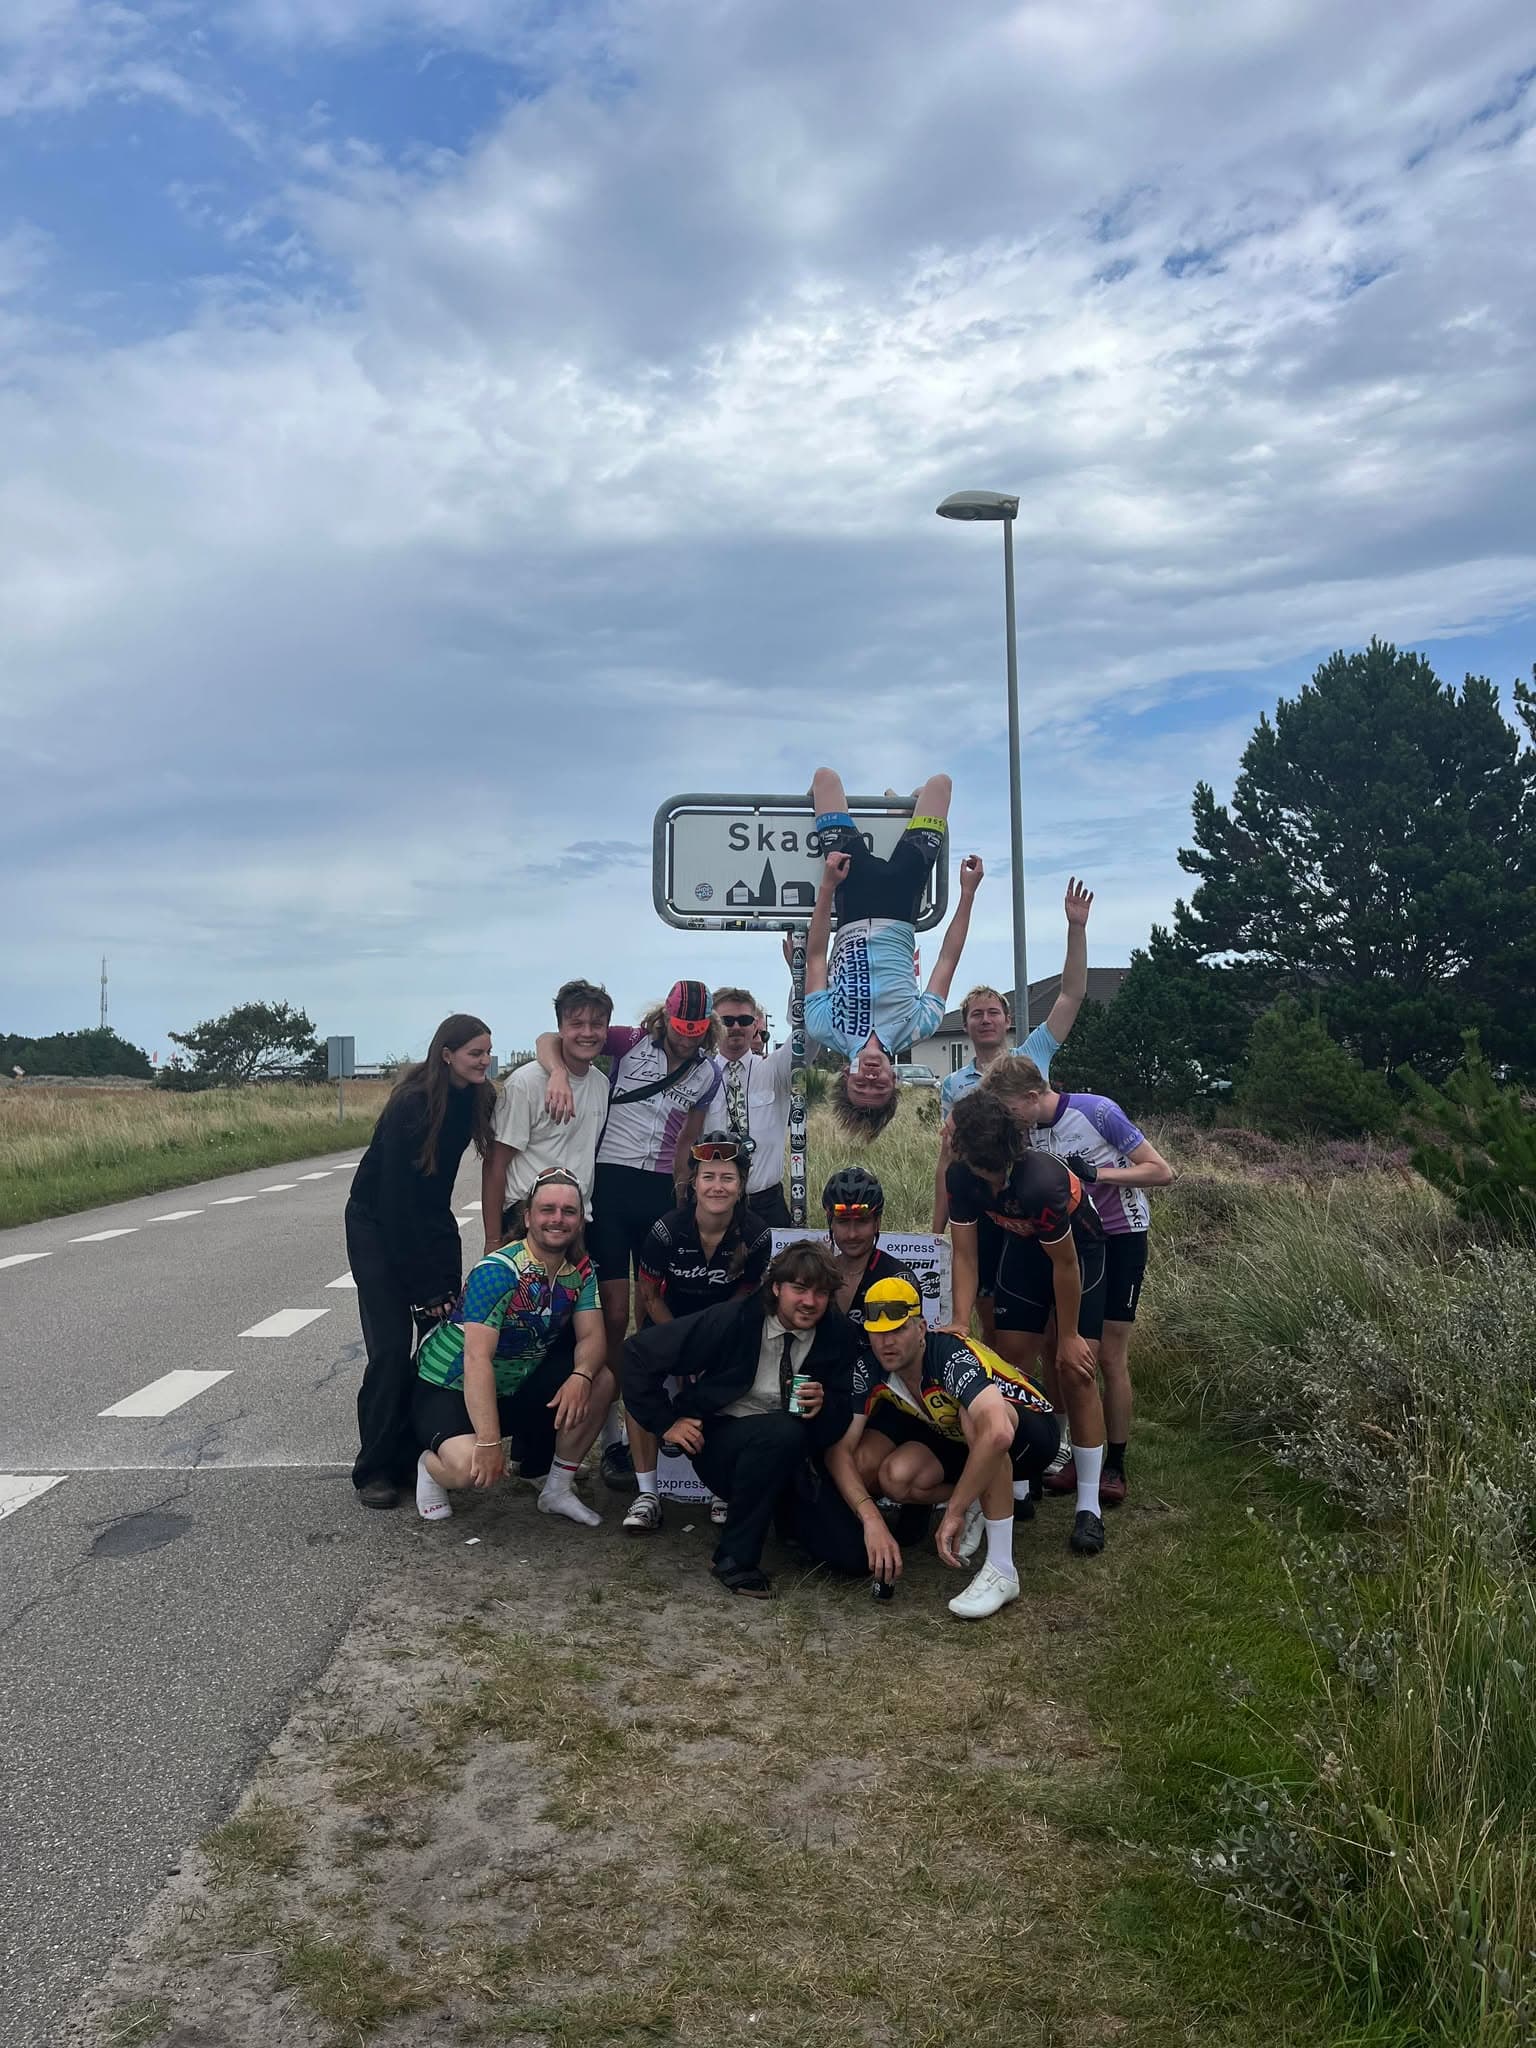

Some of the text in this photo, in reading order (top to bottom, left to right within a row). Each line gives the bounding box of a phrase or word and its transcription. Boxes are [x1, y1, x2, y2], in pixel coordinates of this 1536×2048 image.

[728, 822, 874, 858] Skagn
[887, 1242, 935, 1254] express
[919, 1274, 940, 1287] Sort
[657, 1479, 705, 1490] express
